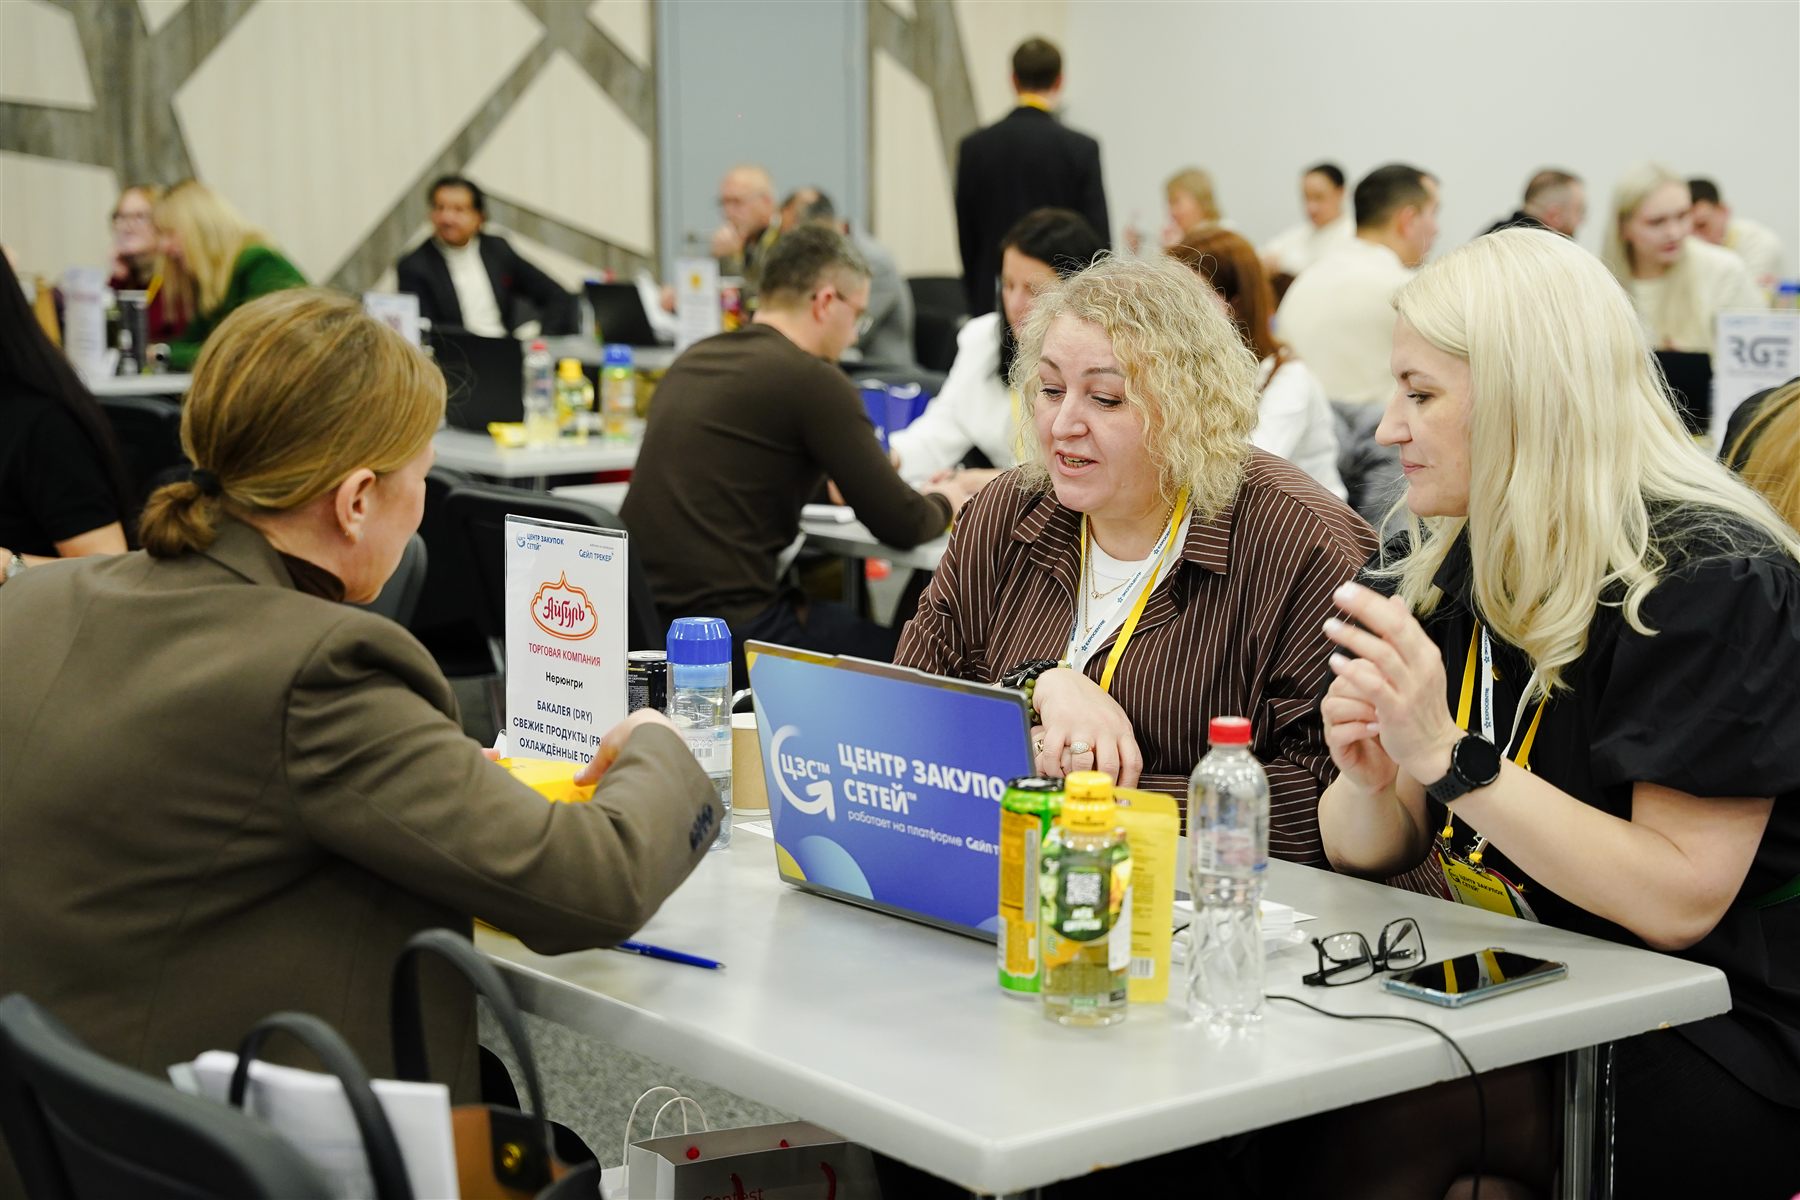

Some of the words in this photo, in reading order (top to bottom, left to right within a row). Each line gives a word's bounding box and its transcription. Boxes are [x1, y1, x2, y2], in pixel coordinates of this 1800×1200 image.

[541, 535, 565, 545] ЗАКУПОК
[543, 597, 585, 628] Айгуль
[1085, 619, 1106, 646] EXPOCENTRE
[529, 643, 561, 658] ТОРГОВАЯ
[563, 650, 600, 666] КОМПАНИЯ
[545, 672, 583, 689] Нерюнгри
[537, 700, 571, 717] БАКАЛЕЯ
[572, 706, 593, 725] (DRY)
[512, 716, 544, 734] СВЕЖИЕ
[545, 724, 588, 744] ПРОДУКТЫ
[589, 734, 601, 748] (FR
[519, 737, 578, 761] ОХЛАЖДЁННЫЕ
[837, 742, 908, 780] ЦЕНТР
[911, 759, 1006, 803] ЗАКУПО
[847, 810, 892, 830] работает
[892, 821, 906, 834] на
[907, 825, 963, 848] платформе
